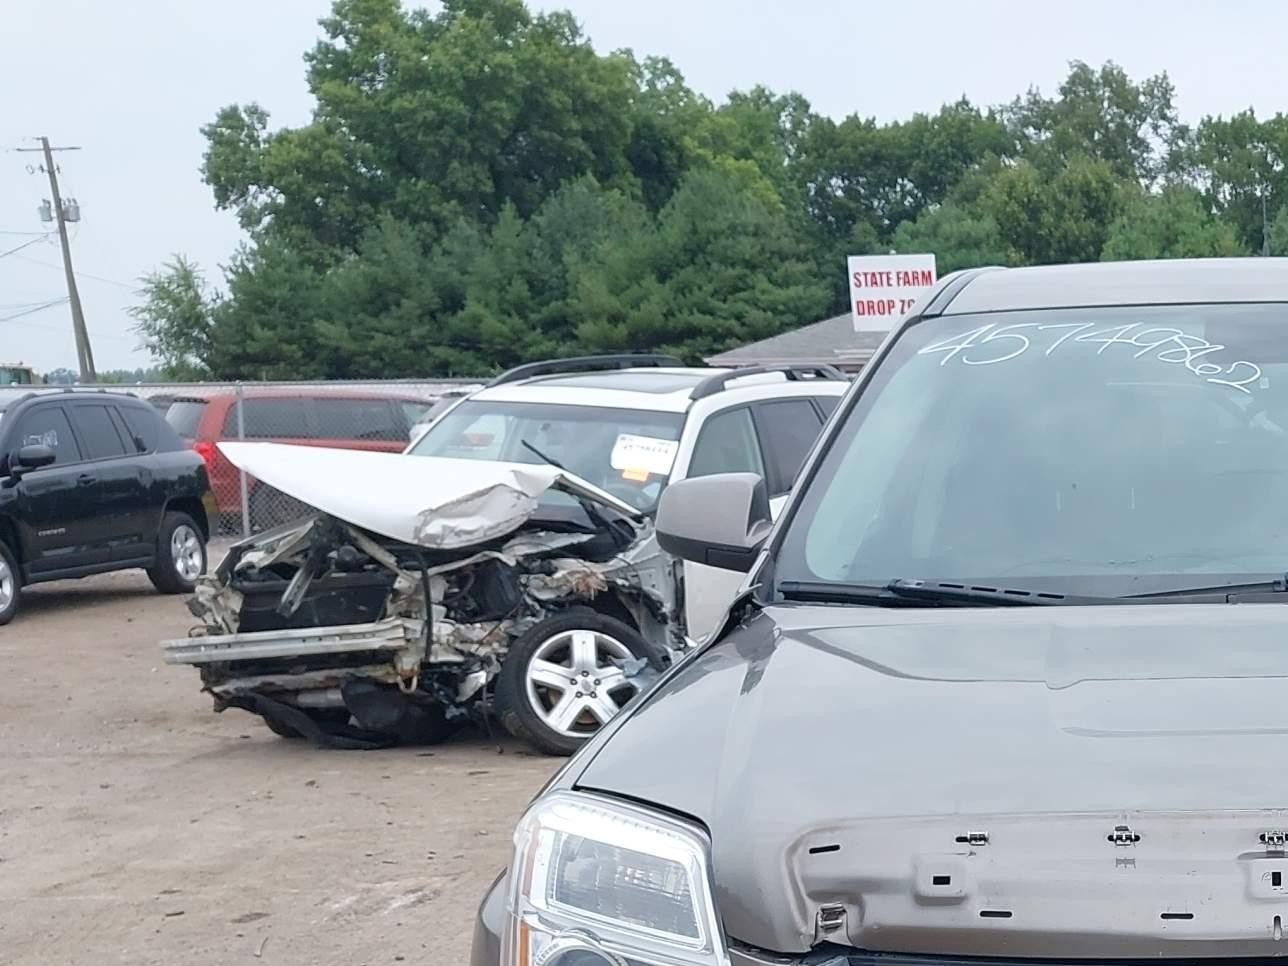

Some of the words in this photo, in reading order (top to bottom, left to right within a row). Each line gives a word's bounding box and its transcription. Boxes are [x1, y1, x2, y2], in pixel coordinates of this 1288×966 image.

[853, 271, 893, 288] STATE
[896, 270, 933, 287] FARM
[856, 299, 896, 316] DROP
[917, 321, 1262, 393] 45749862
